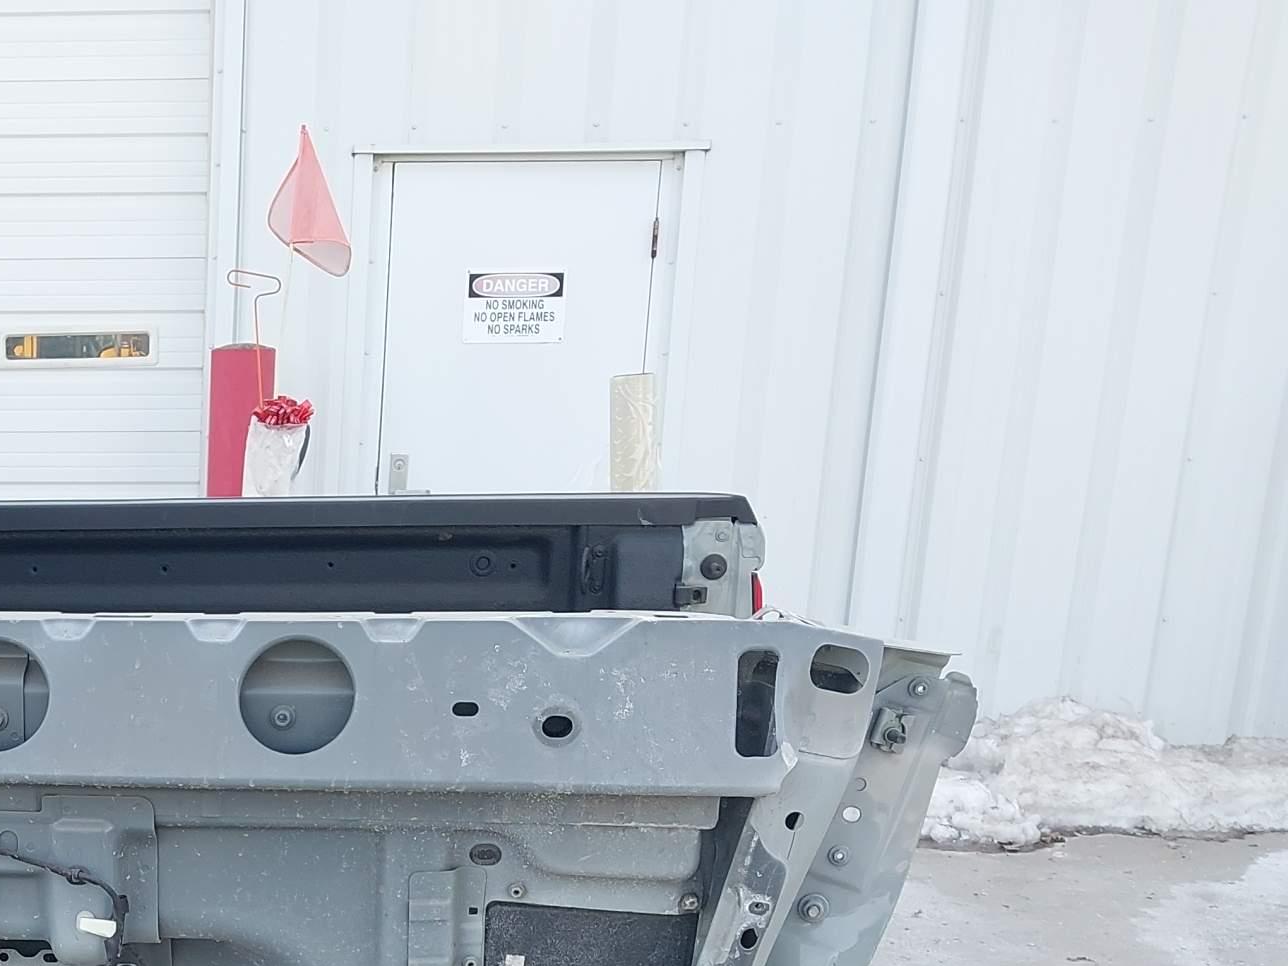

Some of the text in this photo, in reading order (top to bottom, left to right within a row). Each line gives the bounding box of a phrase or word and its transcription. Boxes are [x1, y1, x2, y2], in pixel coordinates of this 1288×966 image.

[482, 279, 549, 292] DANGER
[486, 299, 545, 310] NO SMOKING
[474, 311, 555, 322] NO OPEN FLAMES
[488, 324, 540, 334] NO SPARKS
